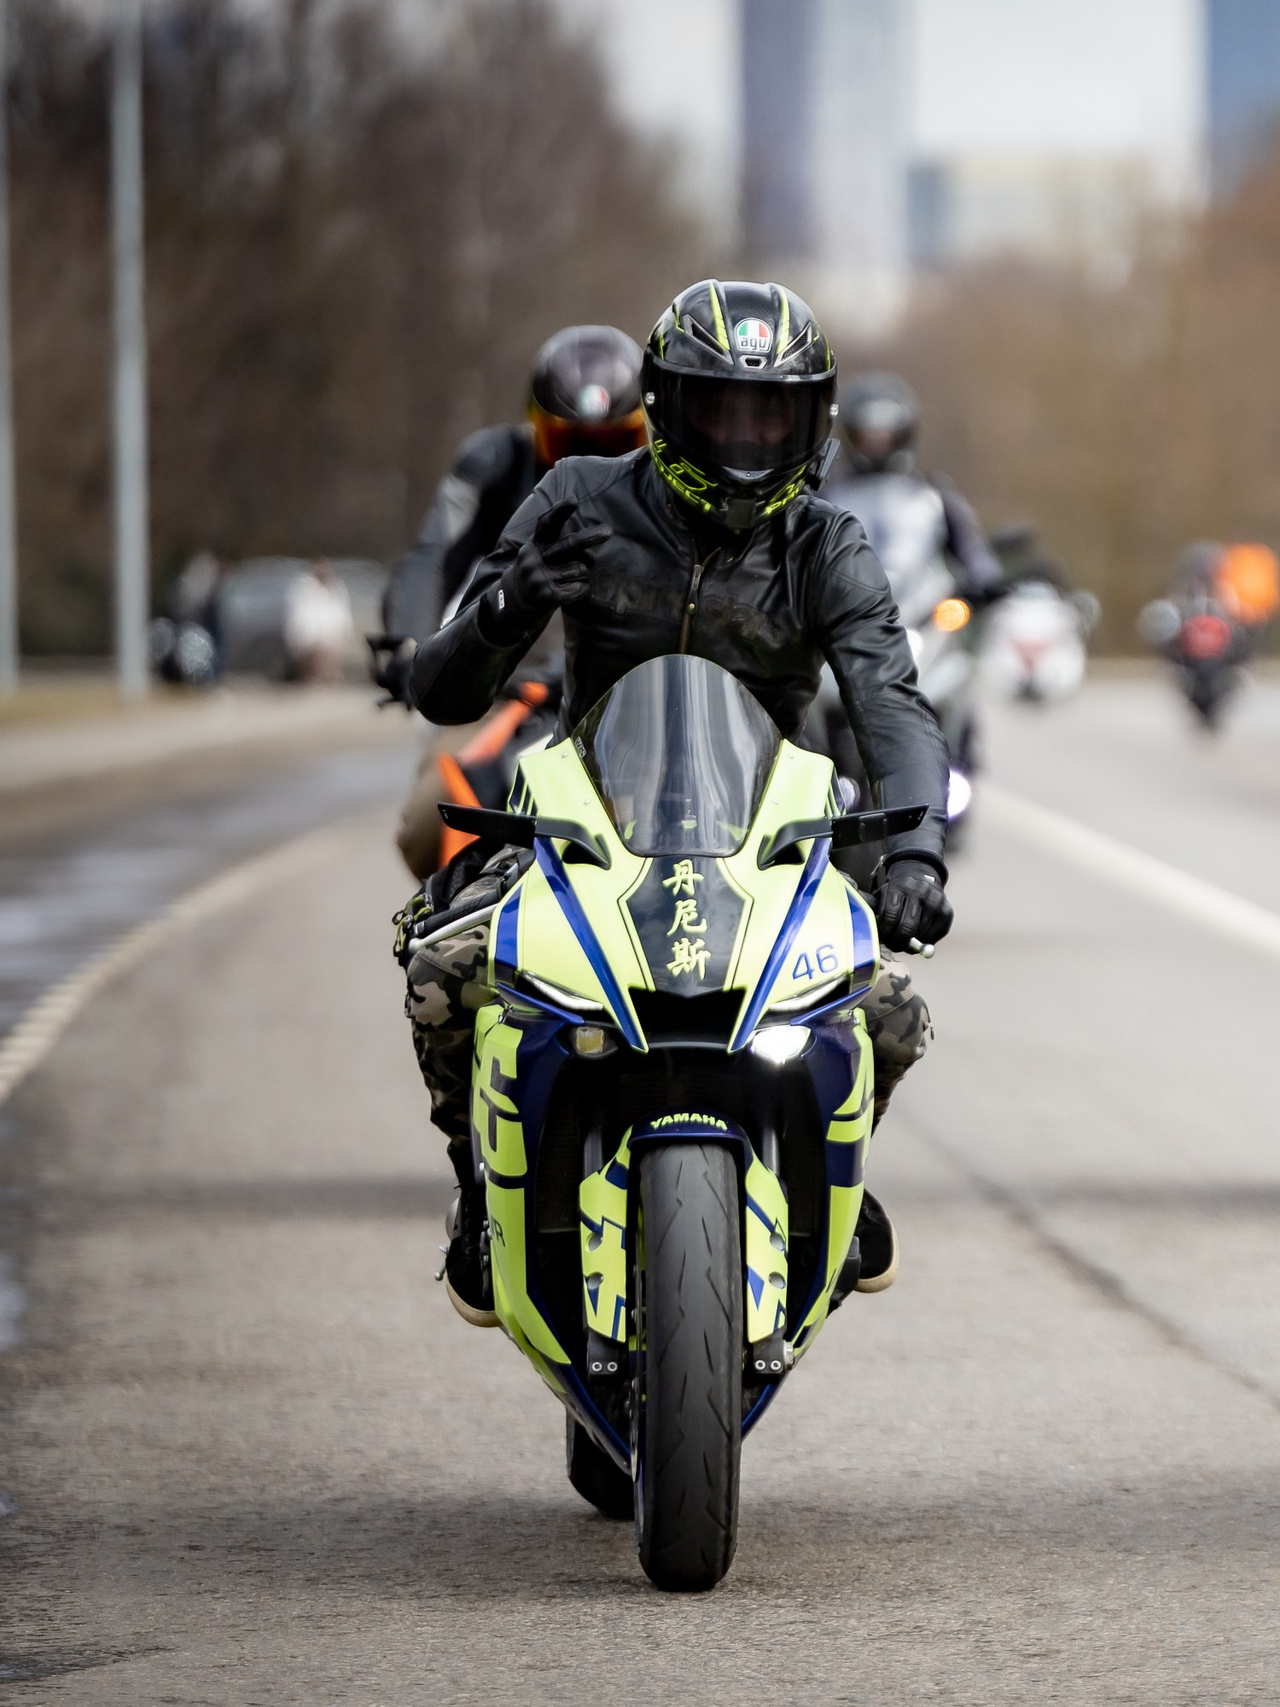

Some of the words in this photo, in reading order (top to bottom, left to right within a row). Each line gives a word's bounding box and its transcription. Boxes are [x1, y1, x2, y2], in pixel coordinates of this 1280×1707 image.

[662, 859, 712, 981] 丹尼斯
[792, 944, 839, 980] 46
[650, 1113, 728, 1131] YAMAHA
